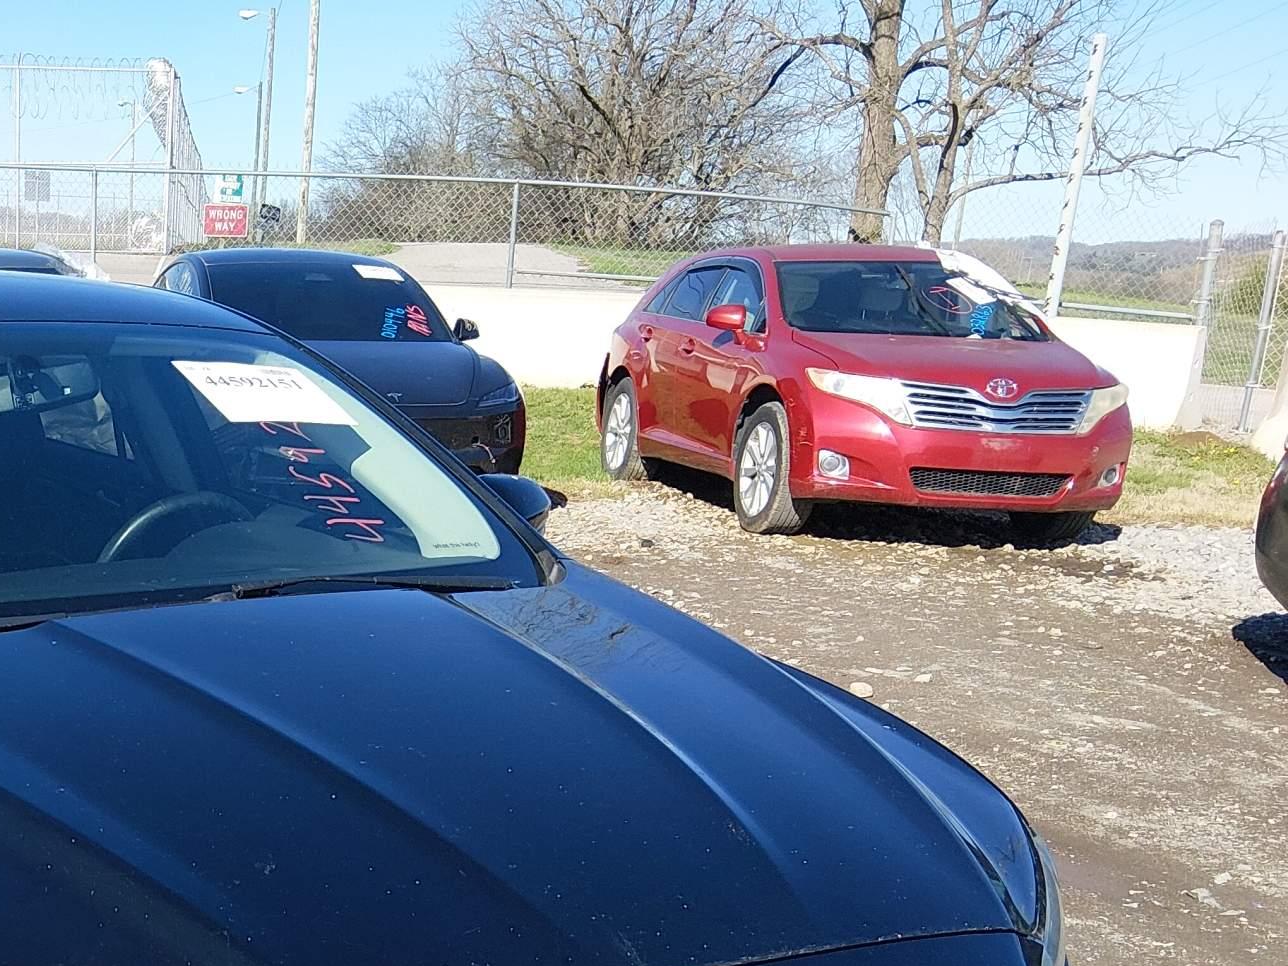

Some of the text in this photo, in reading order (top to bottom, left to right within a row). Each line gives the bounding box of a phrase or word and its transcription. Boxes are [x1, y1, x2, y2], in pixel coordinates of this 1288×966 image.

[208, 209, 244, 220] WRONG
[215, 221, 236, 232] WAY
[204, 375, 303, 391] 44592151
